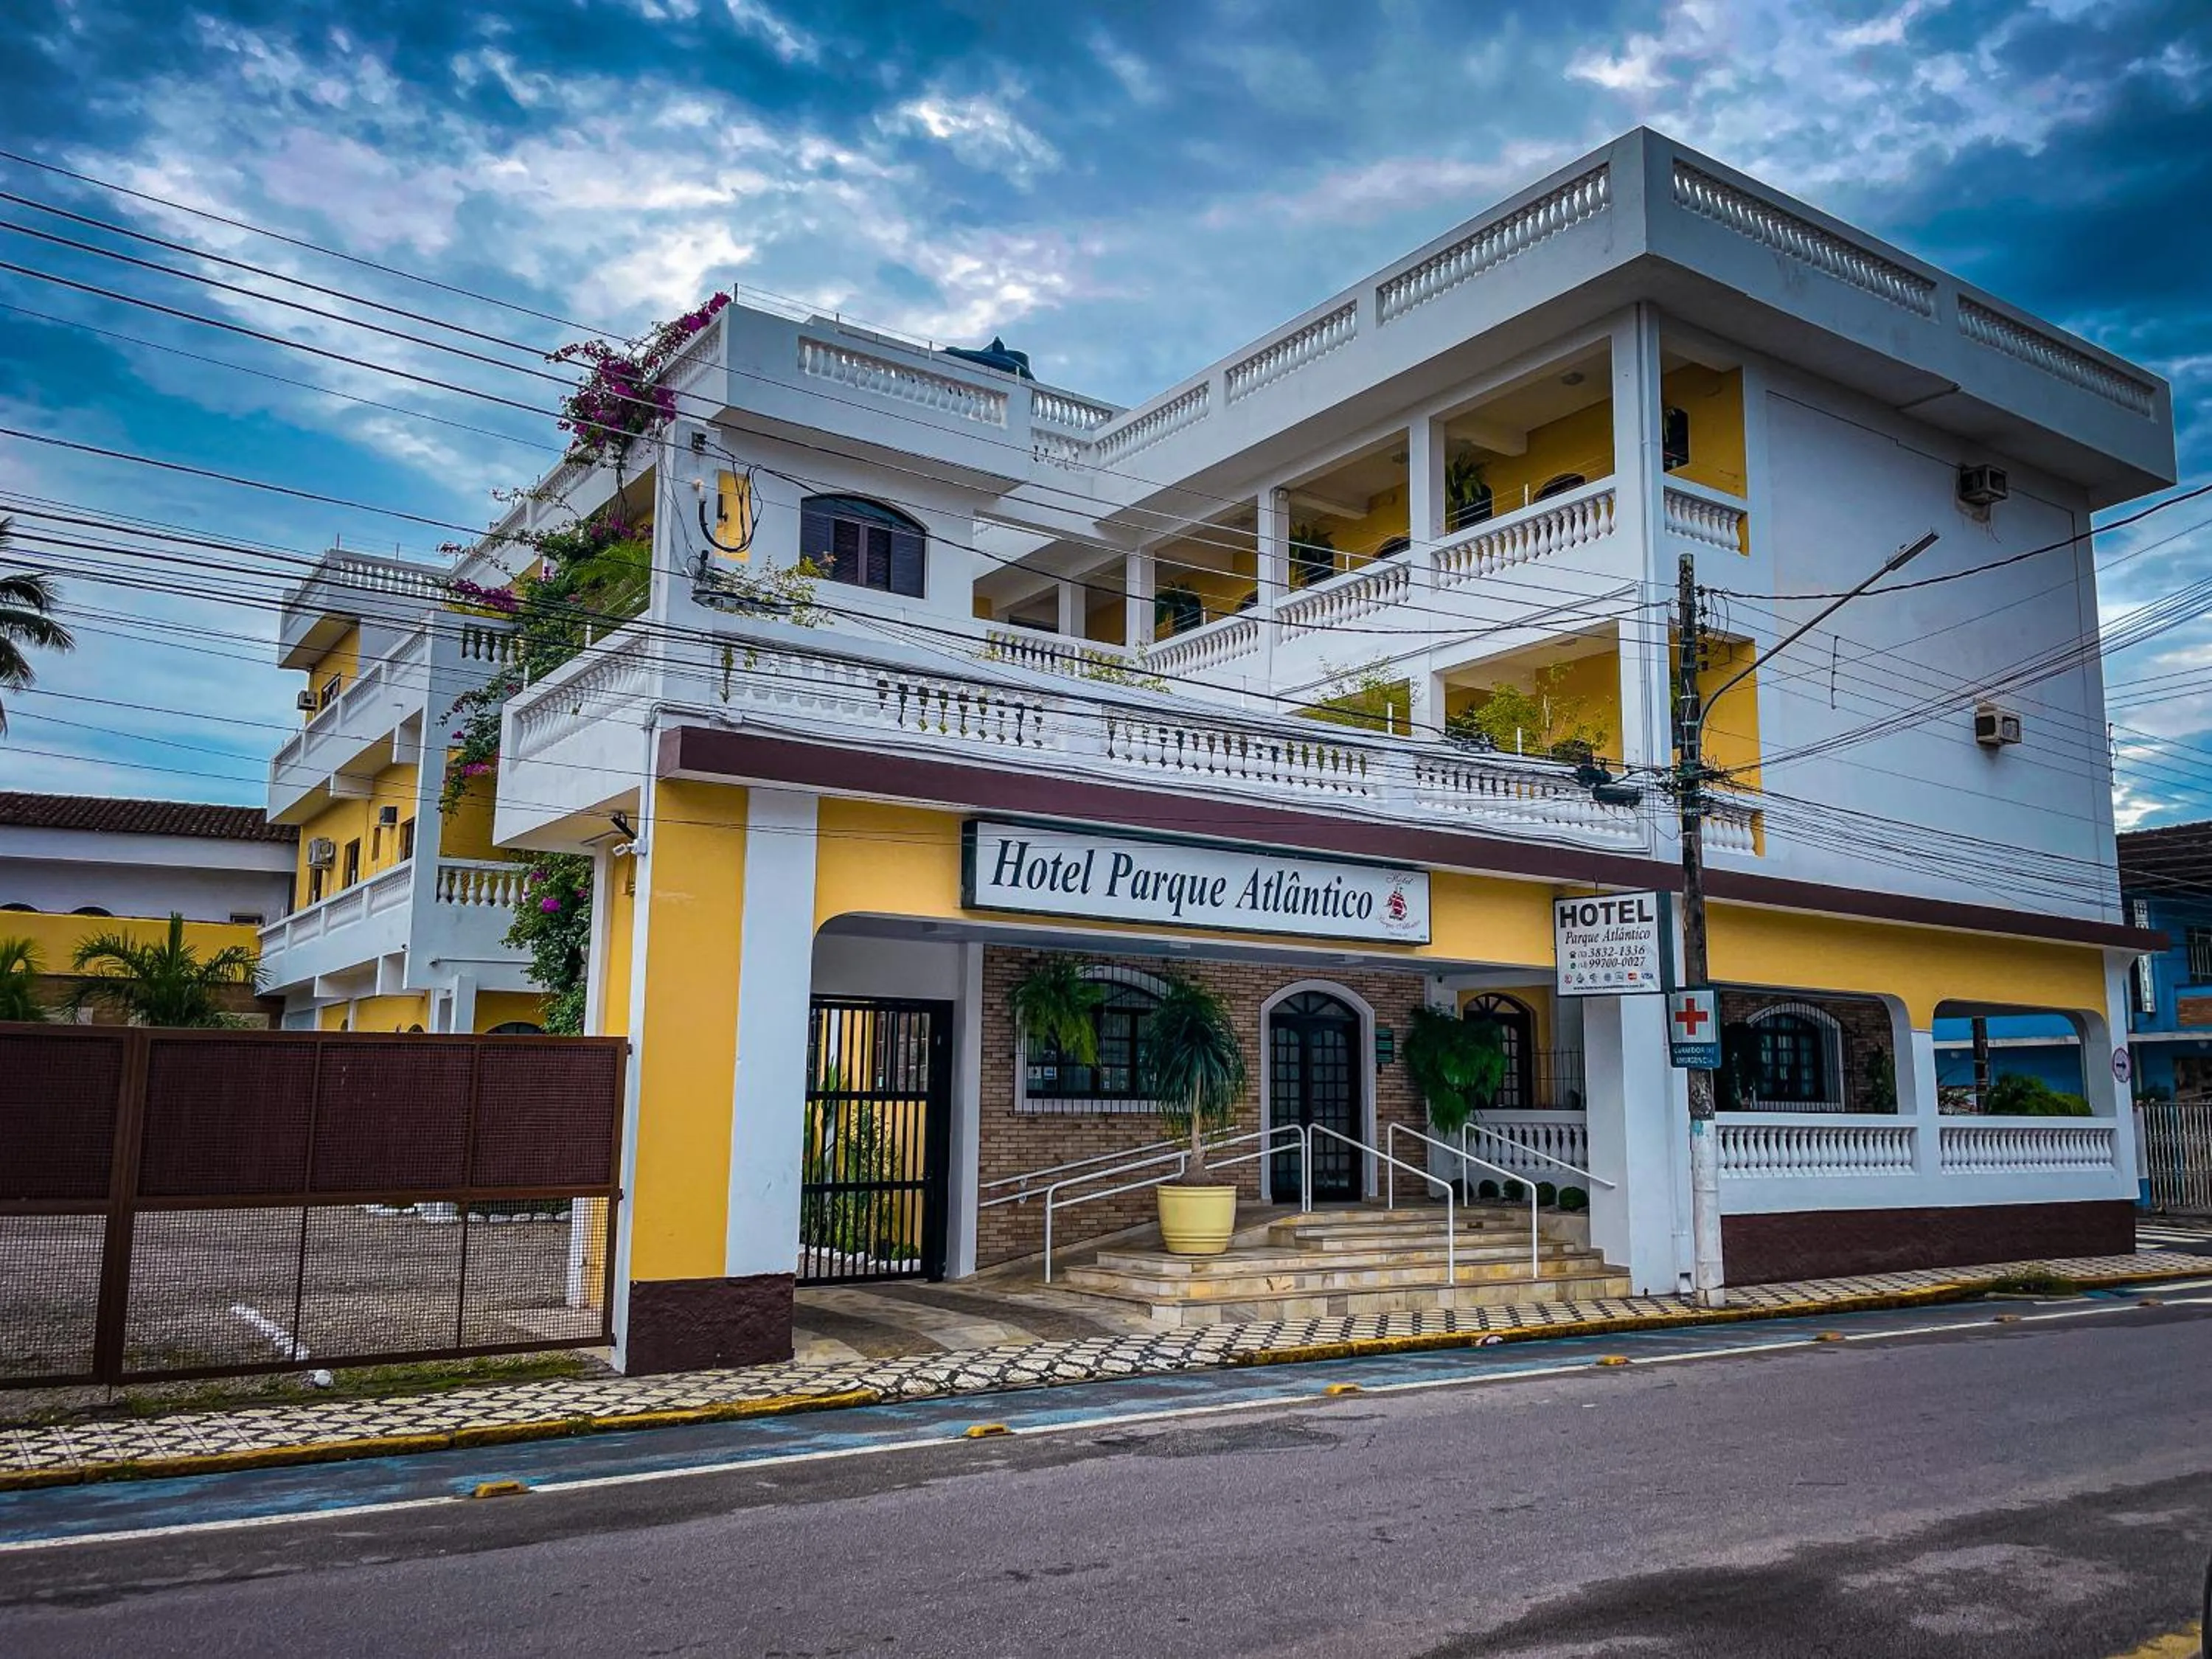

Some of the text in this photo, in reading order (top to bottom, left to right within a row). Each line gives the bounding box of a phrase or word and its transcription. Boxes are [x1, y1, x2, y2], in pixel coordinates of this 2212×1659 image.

[990, 838, 1372, 919] Hotel Parque Atlântico
[1559, 899, 1654, 928] HOTEL
[1565, 931, 1600, 947] Parque
[1587, 945, 1645, 958] 3832-1336
[1588, 957, 1646, 969] 99700-0027
